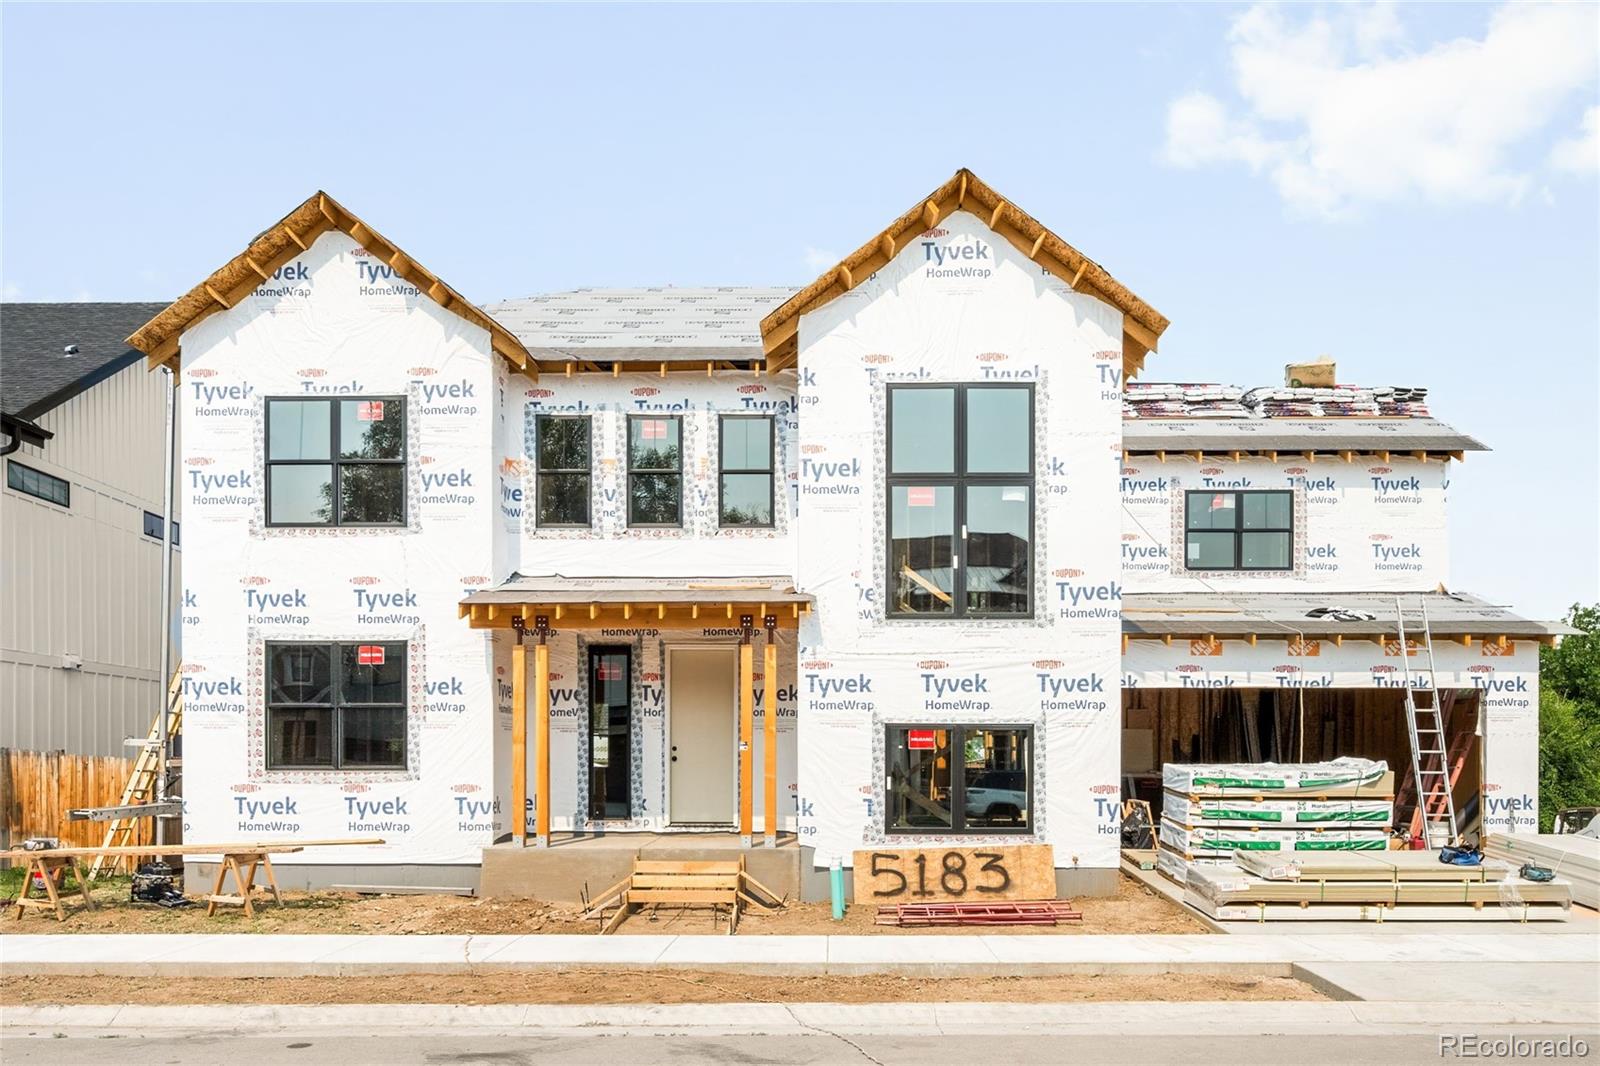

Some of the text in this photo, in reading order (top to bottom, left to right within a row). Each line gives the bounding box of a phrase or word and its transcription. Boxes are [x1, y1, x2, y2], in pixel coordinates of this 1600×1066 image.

[922, 241, 988, 265] Tyvek
[273, 262, 308, 280] vek
[356, 262, 403, 284] Tyv
[927, 268, 991, 278] HomeWrap
[360, 286, 420, 297] HomeWrap
[865, 354, 890, 363] DUPONT
[301, 369, 324, 377] DUPONT
[411, 368, 434, 376] DUPONT
[192, 382, 254, 404] Tyvek
[528, 390, 552, 398] DUPONT
[634, 388, 657, 396] DUPONT
[740, 385, 764, 393] DUPONT
[529, 401, 588, 412] Tek
[802, 445, 823, 454] UPONT
[420, 456, 433, 464] ONT
[189, 470, 251, 493] Tyvek
[421, 469, 472, 492] yvek
[1122, 478, 1166, 494] Tyvek
[1288, 478, 1334, 490] Tvek
[1371, 478, 1419, 494] Tyvek
[803, 485, 859, 495] HomeWra
[193, 496, 256, 505] HomeWrap
[422, 494, 475, 505] omeWrap
[1306, 496, 1338, 504] meWrap
[1375, 496, 1422, 504] HomeWrap
[1121, 544, 1166, 561] Tyvek
[1307, 544, 1336, 557] vek
[1372, 544, 1420, 560] Tyvek
[1307, 563, 1338, 571] meWrap
[1375, 563, 1422, 571] HomeWrap
[1056, 569, 1080, 577] DUPONT
[1056, 582, 1122, 606] Tyvek
[244, 589, 306, 612] Tyvek
[354, 589, 416, 612] Tyvek
[248, 615, 309, 625] HomeWrap
[358, 615, 419, 625] HomeWrap
[601, 629, 659, 637] HomeWrap
[703, 629, 760, 637] HomeWap
[805, 661, 829, 669] DUPONT
[921, 661, 945, 669] DUPONT
[1036, 661, 1061, 669] DUPONT
[642, 673, 659, 681] UPON
[182, 678, 242, 700] Tyvek
[427, 677, 462, 695] vek
[497, 679, 512, 701] Tyve
[806, 674, 872, 697] Tyvek
[921, 674, 987, 698] Tyvek
[1037, 673, 1103, 697] Tyvek
[1471, 677, 1526, 696] Tyvek
[550, 689, 581, 706] yve
[753, 685, 797, 706] yek
[185, 703, 244, 713] HomeWrap
[425, 703, 465, 712] meWrap
[810, 700, 874, 711] HomeWrap
[925, 700, 989, 712] HomeWrap
[1041, 700, 1106, 711] HomeWrap
[1482, 698, 1529, 707] omeWrap
[234, 784, 258, 792] DUPONT
[344, 785, 368, 793] DUPONT
[1093, 785, 1118, 793] DUPONT
[234, 797, 296, 819] Tyvek
[345, 797, 407, 819] Tyvek
[455, 796, 501, 819] Tyvek
[239, 822, 299, 832] HomeWrap
[348, 822, 410, 832] HomeWrap
[871, 852, 1011, 897] 5183
